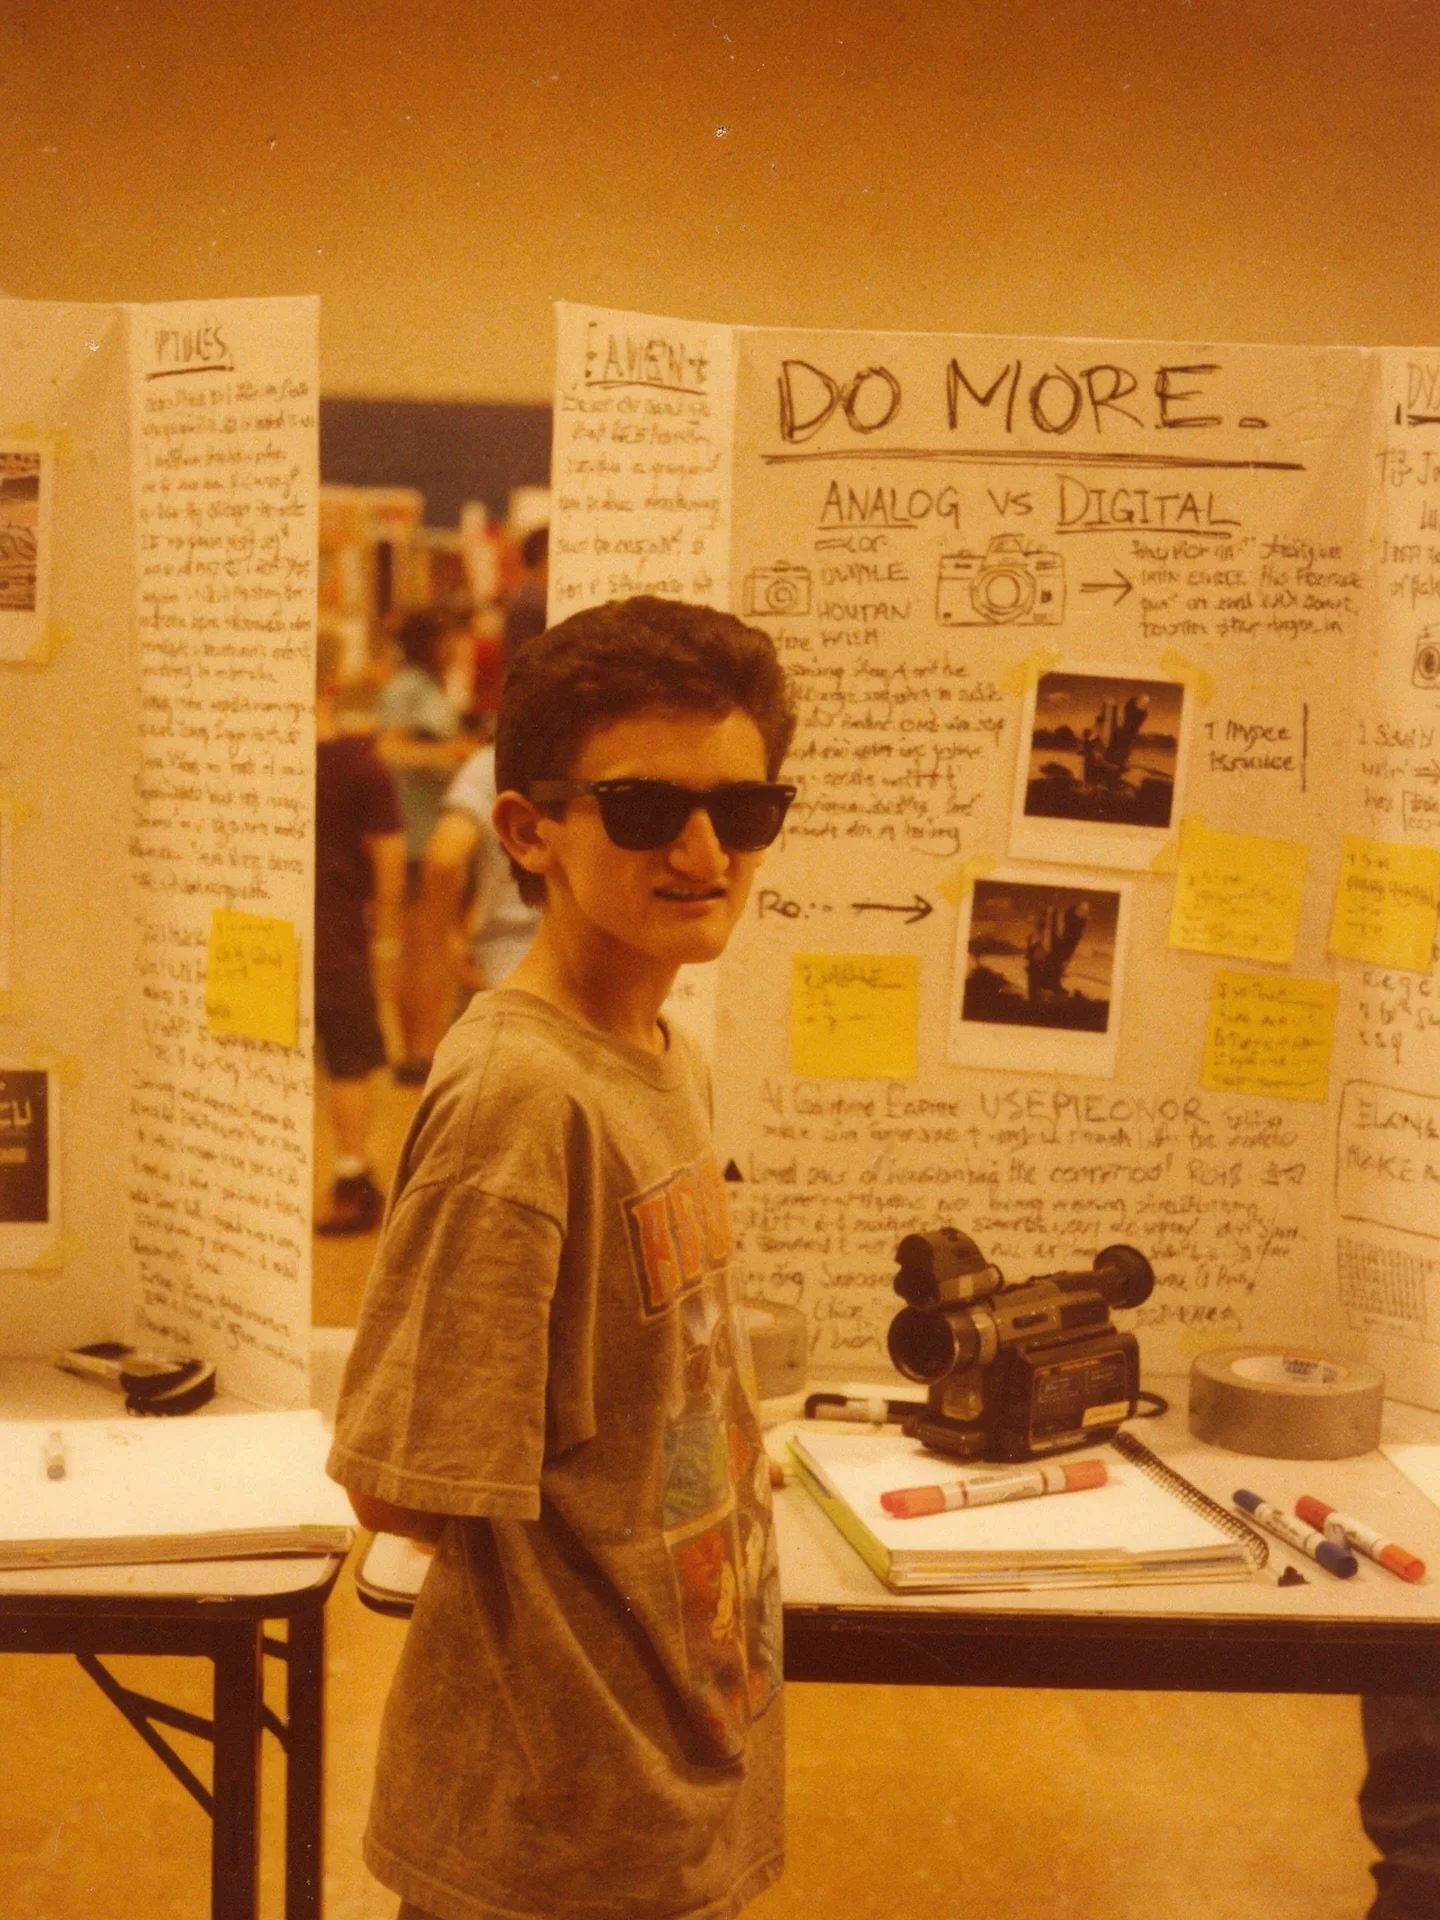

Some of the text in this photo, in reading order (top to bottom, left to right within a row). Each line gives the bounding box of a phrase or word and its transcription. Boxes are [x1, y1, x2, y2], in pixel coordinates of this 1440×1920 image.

[777, 358, 903, 444] DO
[820, 479, 961, 530] ANALOG
[1055, 473, 1242, 528] DIGITAL
